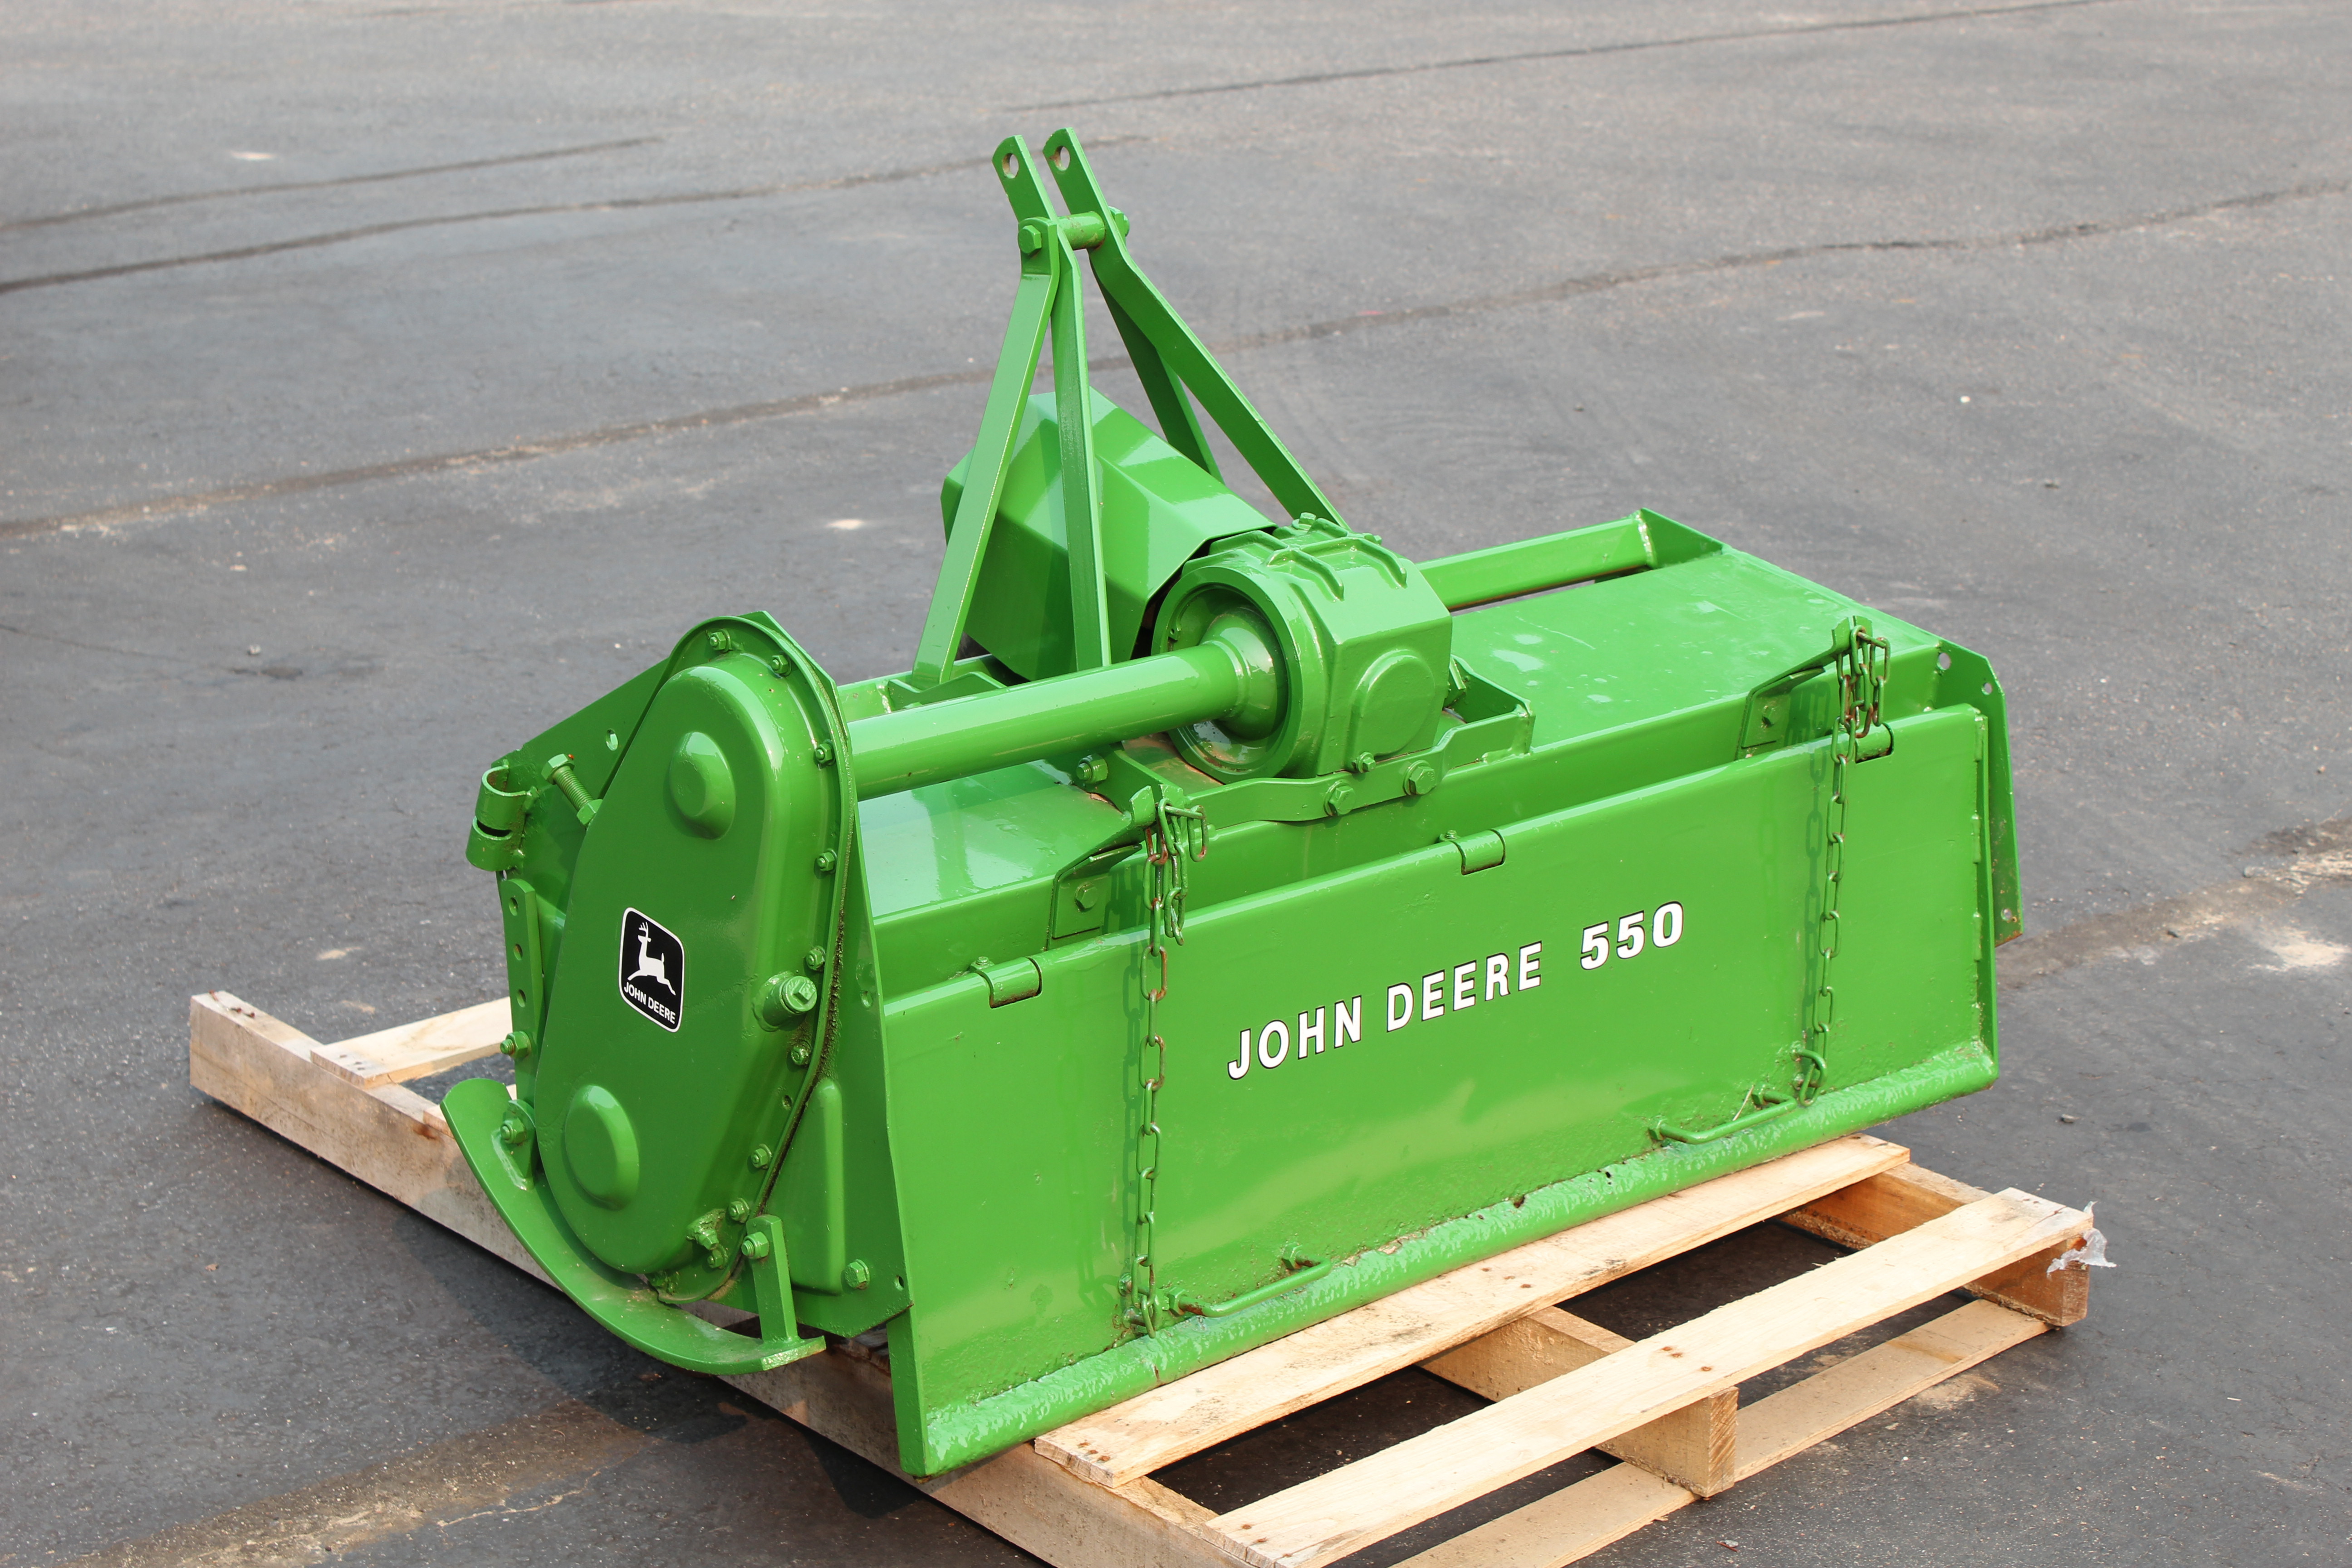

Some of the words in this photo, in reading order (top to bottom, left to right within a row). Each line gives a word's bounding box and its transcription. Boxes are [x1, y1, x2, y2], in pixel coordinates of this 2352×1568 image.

[624, 981, 647, 1005] JOHN
[648, 996, 676, 1024] DEERE
[1228, 995, 1362, 1080] JOHN
[1387, 941, 1542, 1032] DEERE
[1580, 901, 1684, 970] 550
